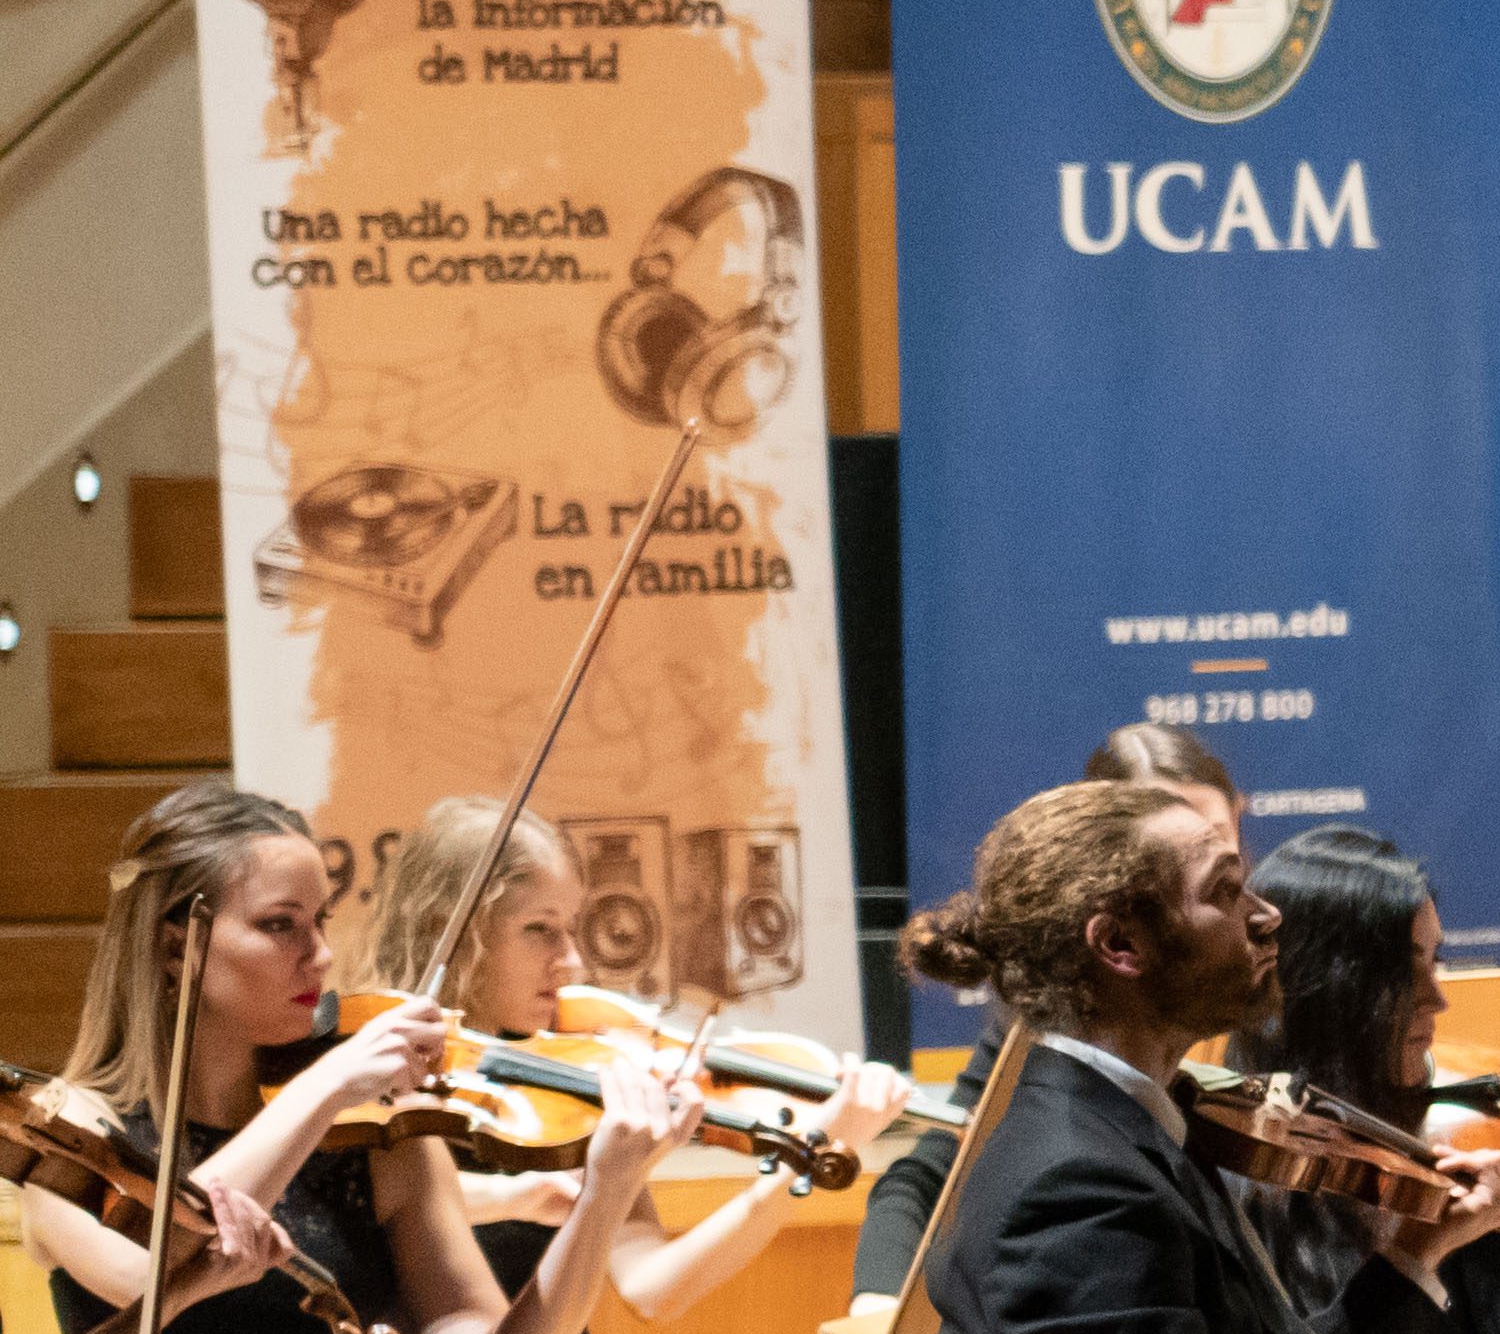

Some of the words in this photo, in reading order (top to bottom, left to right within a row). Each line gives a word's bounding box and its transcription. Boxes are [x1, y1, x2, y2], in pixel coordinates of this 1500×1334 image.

[418, 43, 466, 84] de
[482, 42, 618, 84] Madrid
[262, 208, 341, 243] Una
[358, 198, 469, 241] radio
[484, 198, 609, 239] hecha
[1059, 160, 1380, 255] UCAM
[252, 257, 337, 288] con
[353, 246, 392, 287] el
[407, 248, 610, 285] corazón...
[532, 494, 589, 538] La
[533, 565, 594, 599] en
[614, 547, 797, 598] amilia
[1106, 602, 1347, 644] www.ucam.edu
